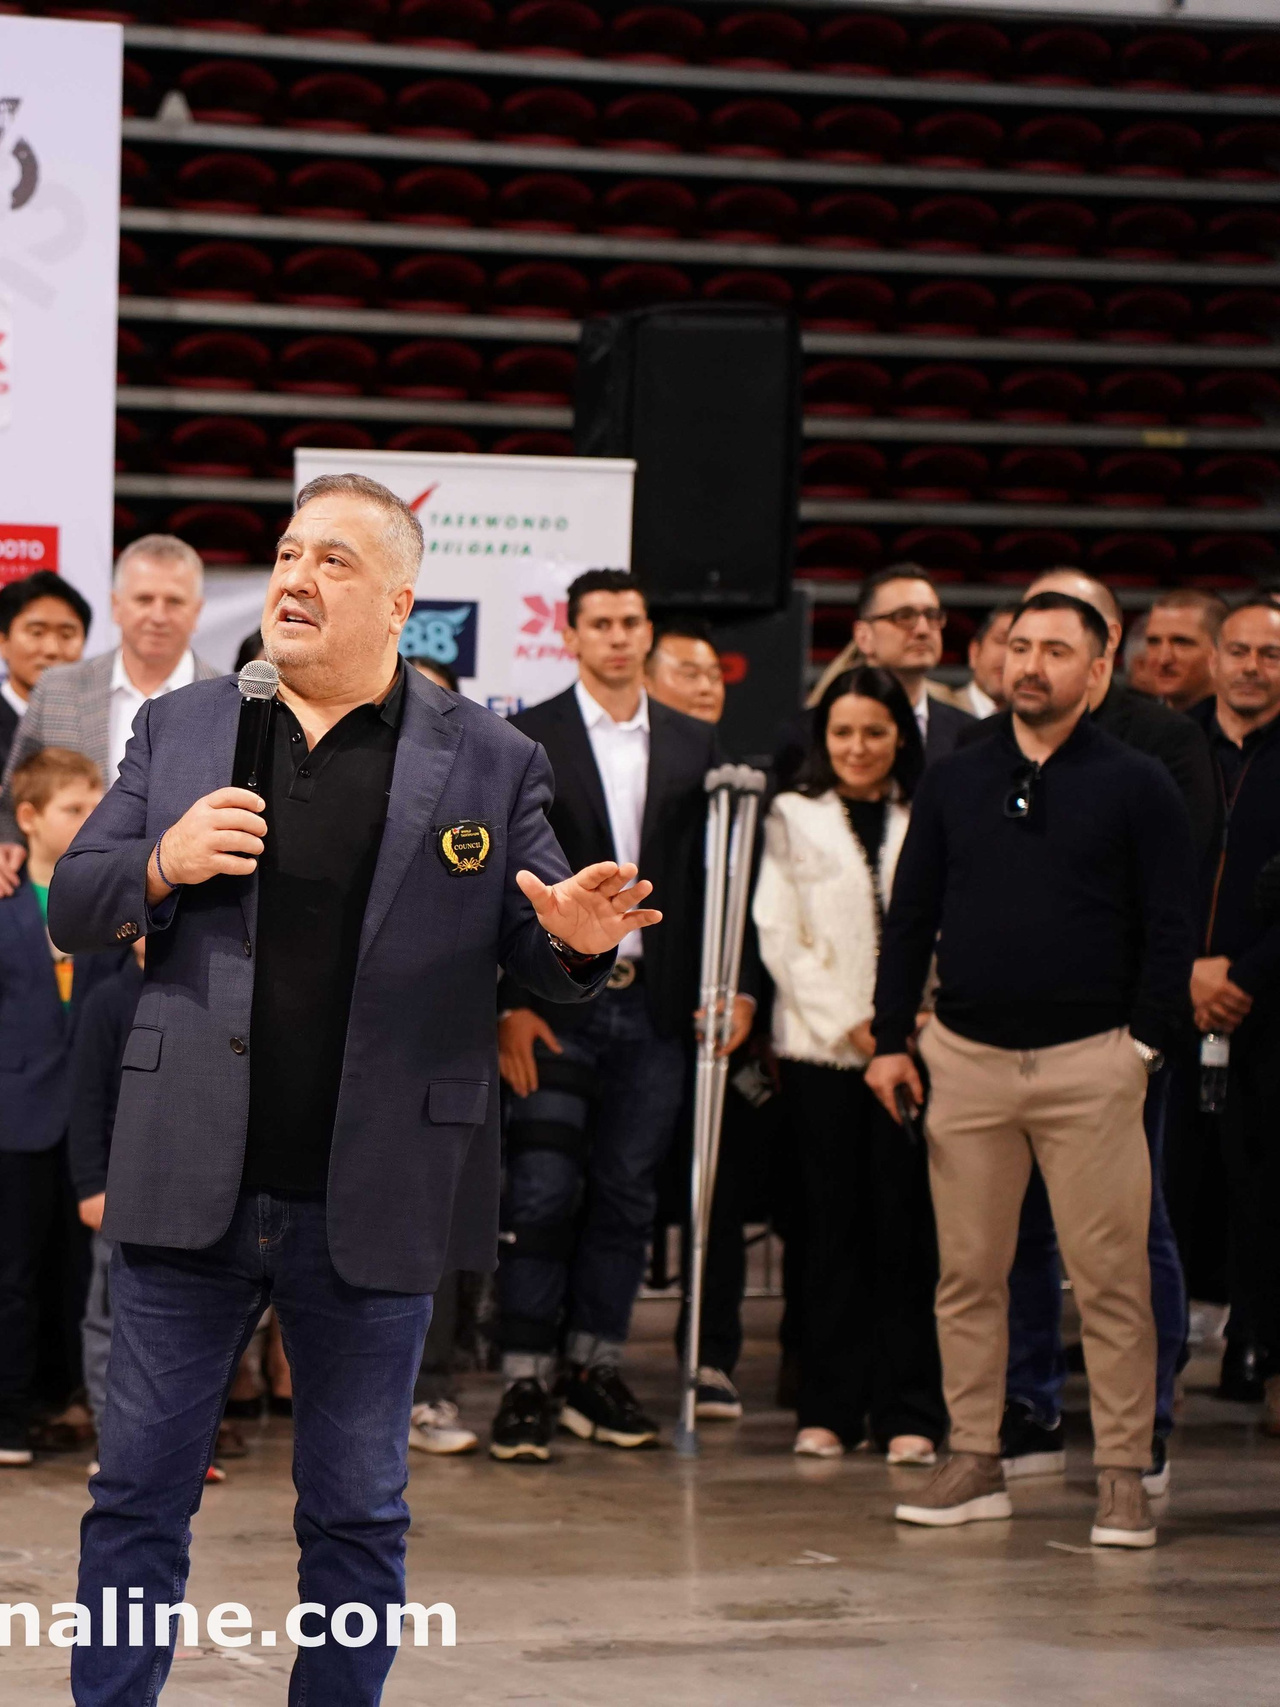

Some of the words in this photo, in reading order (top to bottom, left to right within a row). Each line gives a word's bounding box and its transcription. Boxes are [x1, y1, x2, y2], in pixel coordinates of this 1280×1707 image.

[429, 513, 569, 531] TAEKWONDO
[429, 541, 532, 556] BULGARIA
[454, 842, 482, 851] COUNCIL
